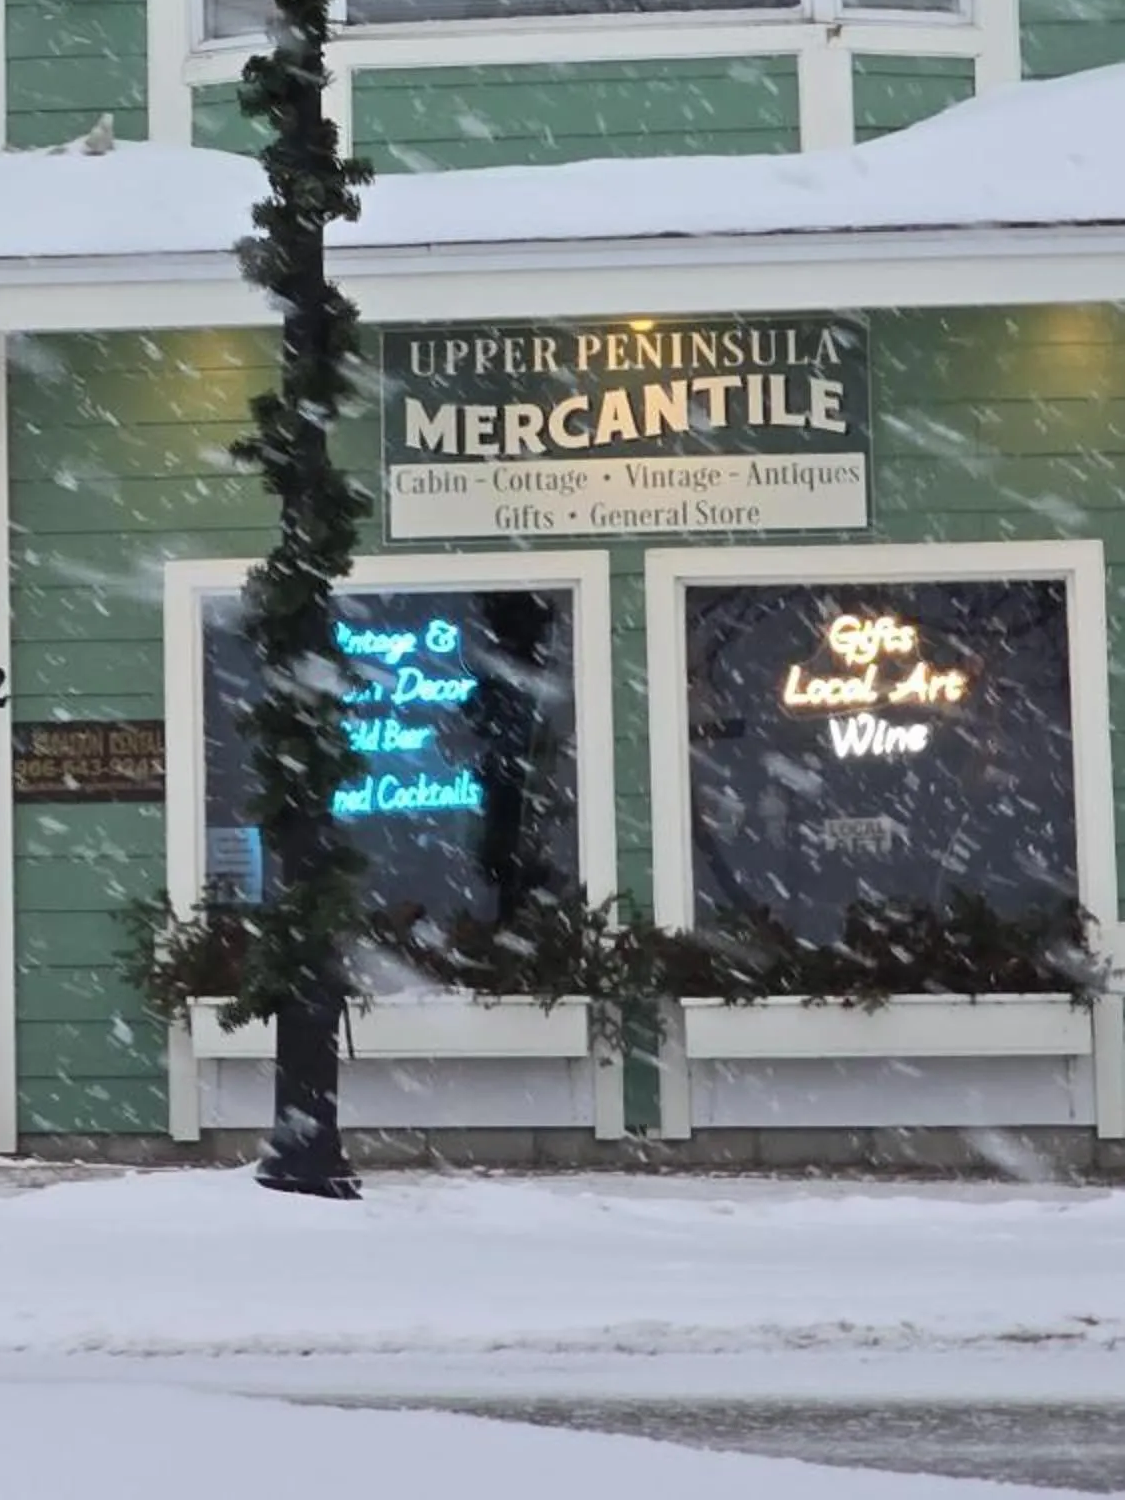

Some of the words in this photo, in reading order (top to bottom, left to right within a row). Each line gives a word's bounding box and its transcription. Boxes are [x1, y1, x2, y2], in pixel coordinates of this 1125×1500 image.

[411, 336, 559, 377] UPPER
[576, 329, 842, 372] PENINSULA
[404, 374, 848, 457] MERCANTILE
[396, 467, 469, 497] Cabin
[492, 466, 588, 502] Cottage
[625, 462, 723, 497] Vintage
[746, 459, 861, 493] Antiques
[495, 504, 555, 533] Gifts
[589, 501, 689, 530] General
[695, 501, 761, 528] Store
[828, 613, 918, 664] Gifts
[390, 666, 478, 705] Decor
[783, 663, 878, 706] Local
[887, 661, 967, 705] Art
[828, 713, 929, 759] Wine
[377, 769, 482, 809] Cocktails
